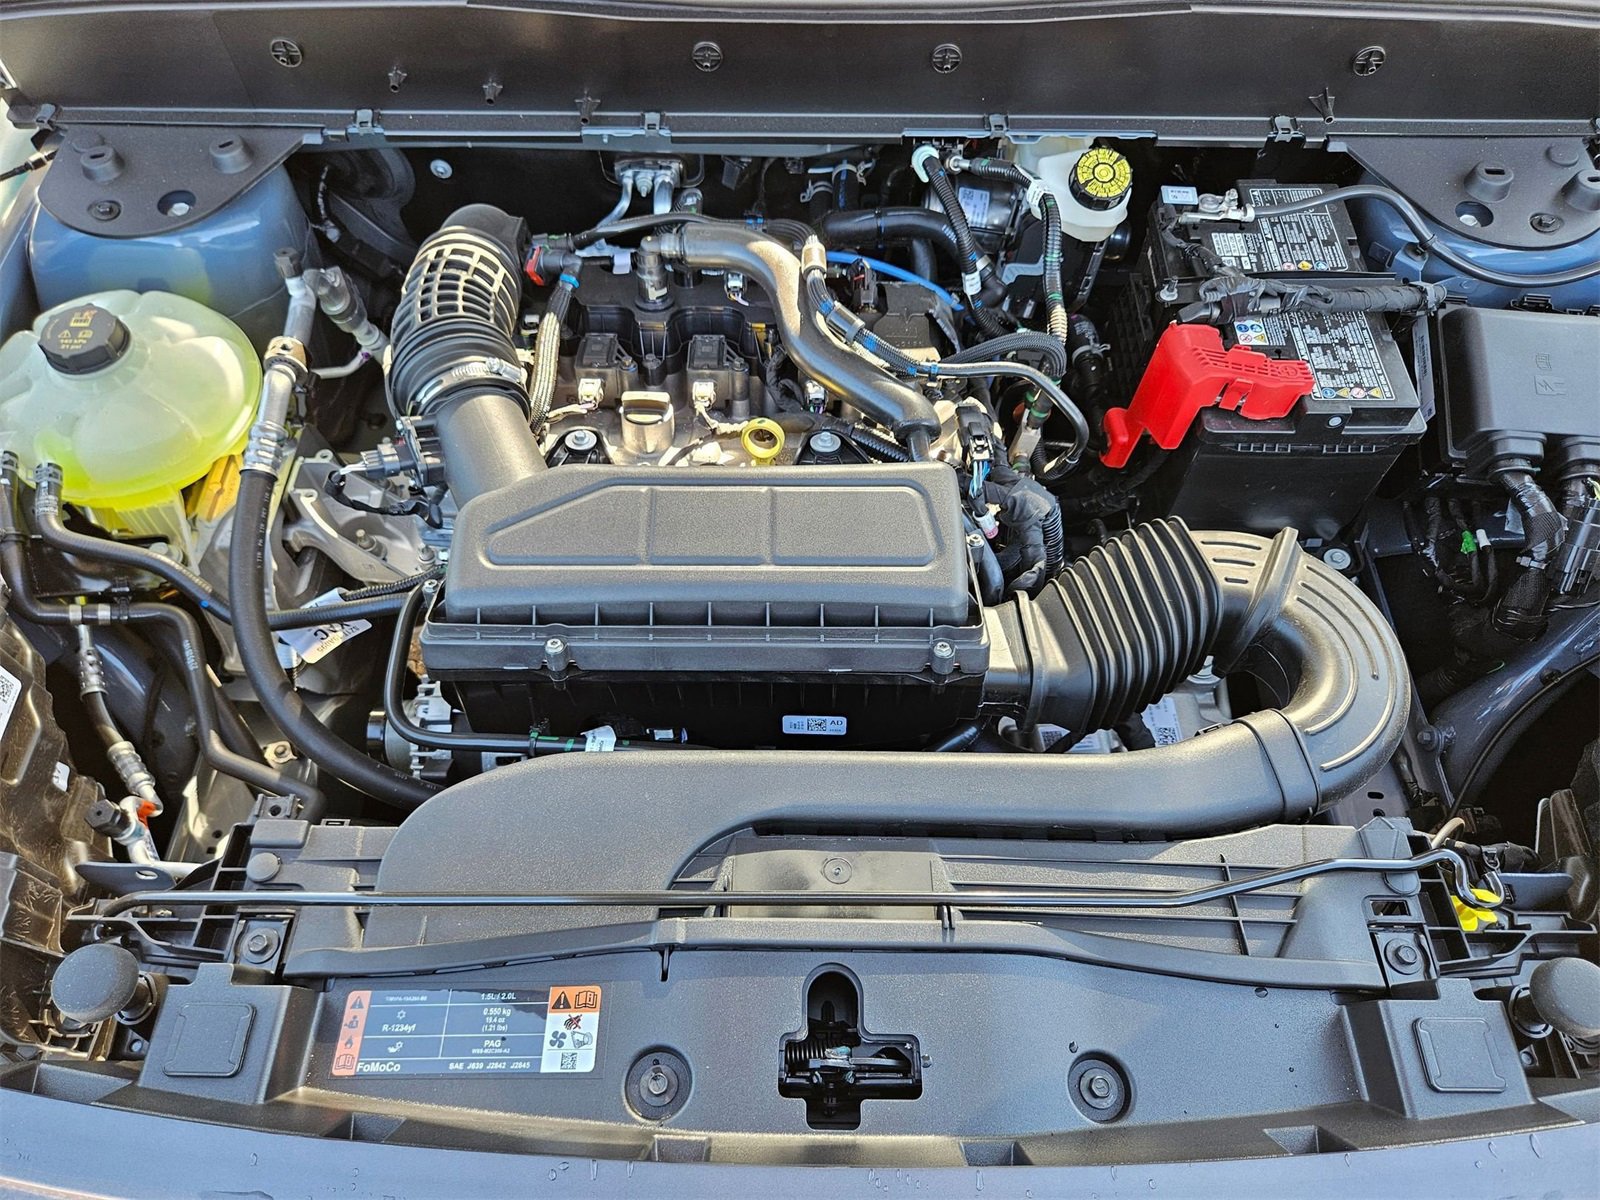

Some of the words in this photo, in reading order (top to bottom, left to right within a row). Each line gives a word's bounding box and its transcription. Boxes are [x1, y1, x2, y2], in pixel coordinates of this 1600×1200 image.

[481, 992, 496, 1000] 1.5L
[501, 992, 517, 1000] 2.0L
[483, 1007, 502, 1016] 0.550
[502, 1007, 512, 1017] kg
[382, 1023, 417, 1034] R-1234yf
[484, 1039, 502, 1048] PAG
[356, 1061, 401, 1073] FoMoCo
[448, 1062, 464, 1070] SAE
